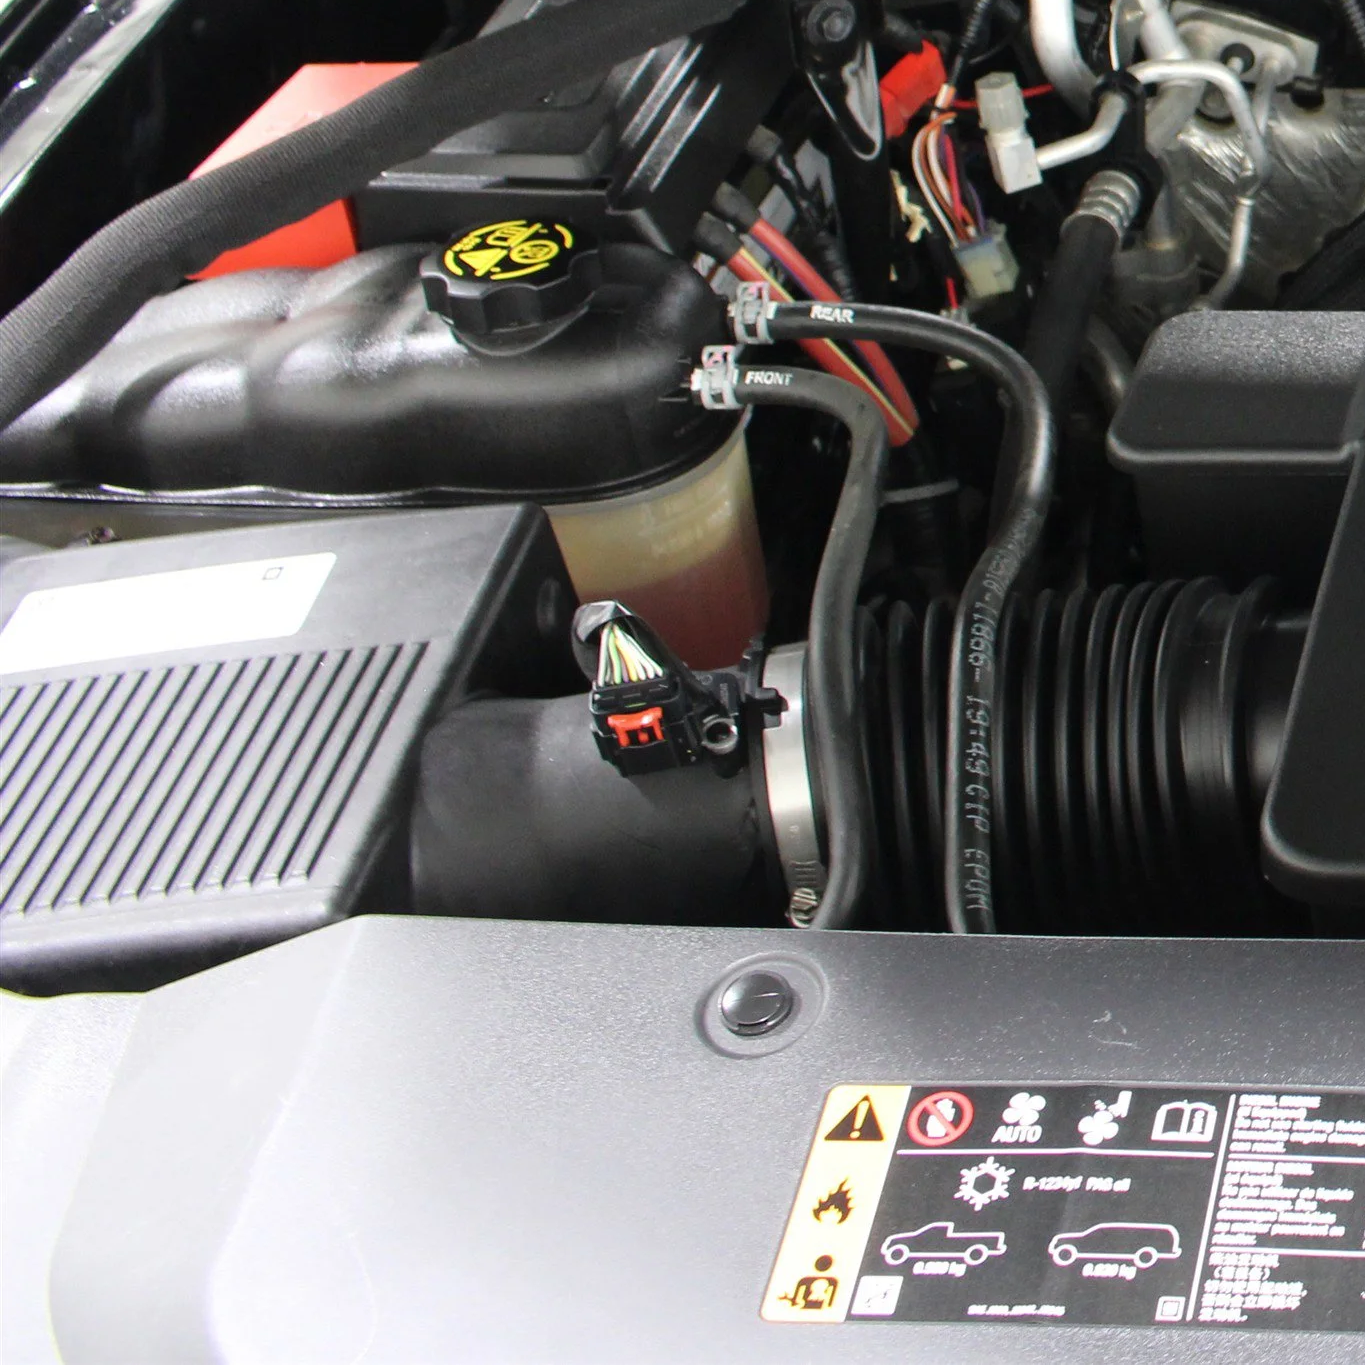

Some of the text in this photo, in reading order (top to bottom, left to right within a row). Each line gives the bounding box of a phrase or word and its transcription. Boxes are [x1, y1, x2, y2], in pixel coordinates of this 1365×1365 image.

[810, 305, 855, 323] REAR
[744, 371, 794, 386] FRONT
[991, 1124, 1042, 1144] AUTO
